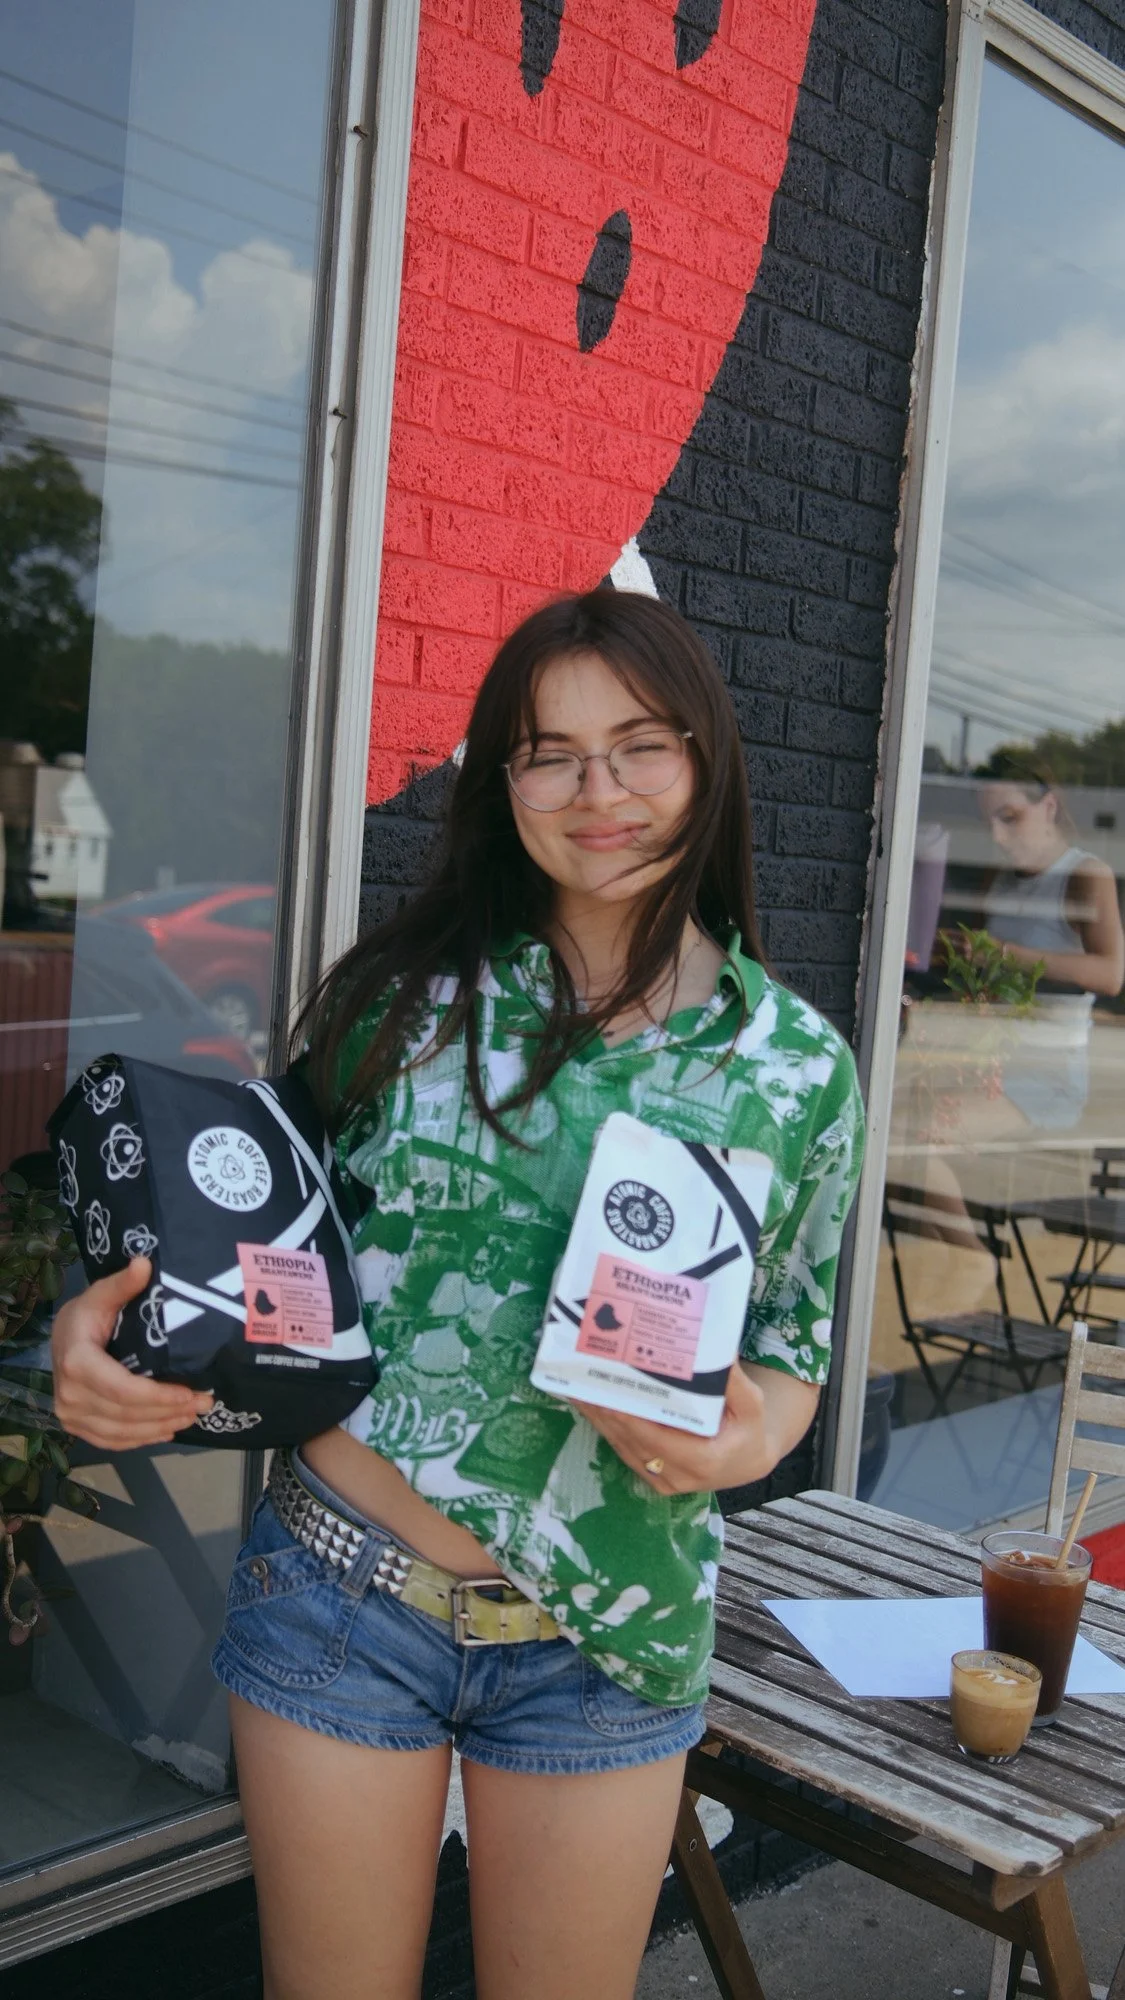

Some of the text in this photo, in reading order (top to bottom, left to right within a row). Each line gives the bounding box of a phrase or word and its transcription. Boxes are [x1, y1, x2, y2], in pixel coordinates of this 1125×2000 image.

[194, 1133, 268, 1205] ATOMIC COFFEE ROASTERS
[606, 1181, 672, 1249] ATOMIC COFFEE ROASTERS
[254, 1255, 316, 1273] ETHIOPIA
[612, 1265, 692, 1300] ETHIOPIA
